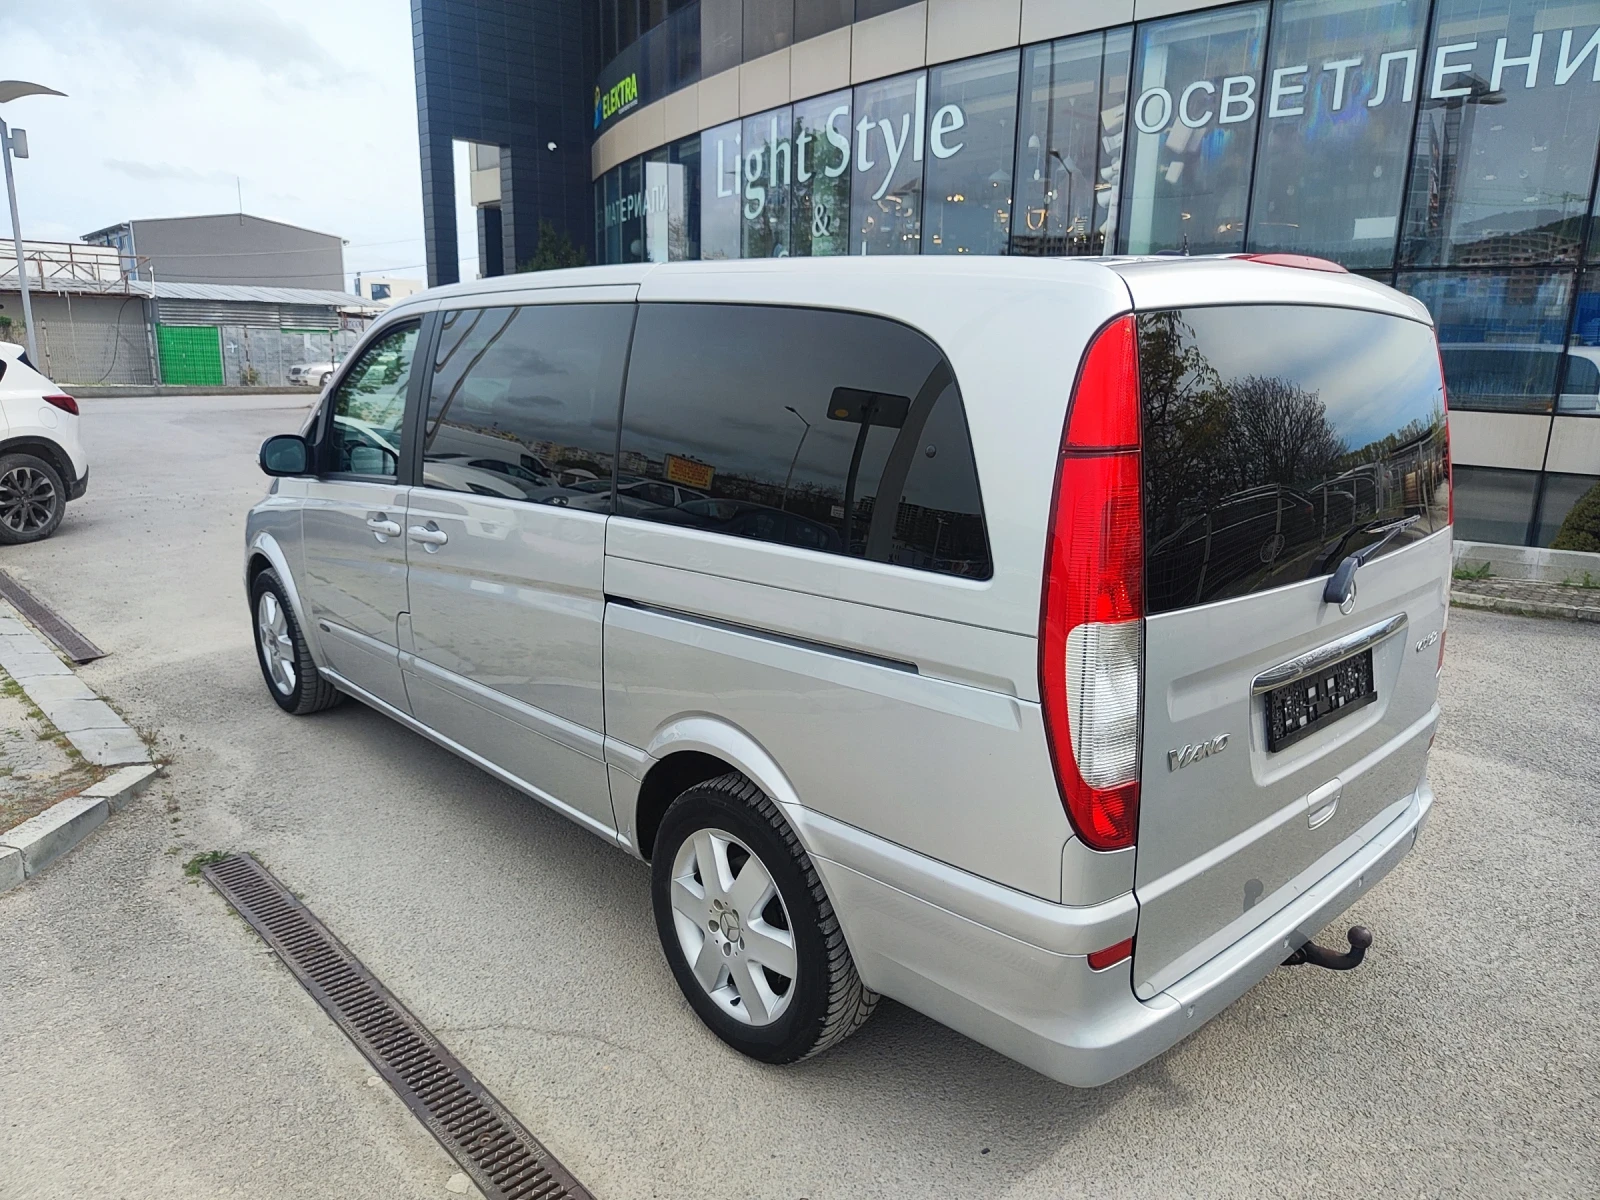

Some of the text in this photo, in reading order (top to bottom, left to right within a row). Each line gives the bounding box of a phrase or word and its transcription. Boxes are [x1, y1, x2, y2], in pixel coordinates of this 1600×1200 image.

[602, 73, 638, 120] ELEKTRA
[1134, 26, 1600, 134] ОСВЕТЛЕНИ
[716, 75, 964, 220] Light Style
[811, 203, 830, 238] &
